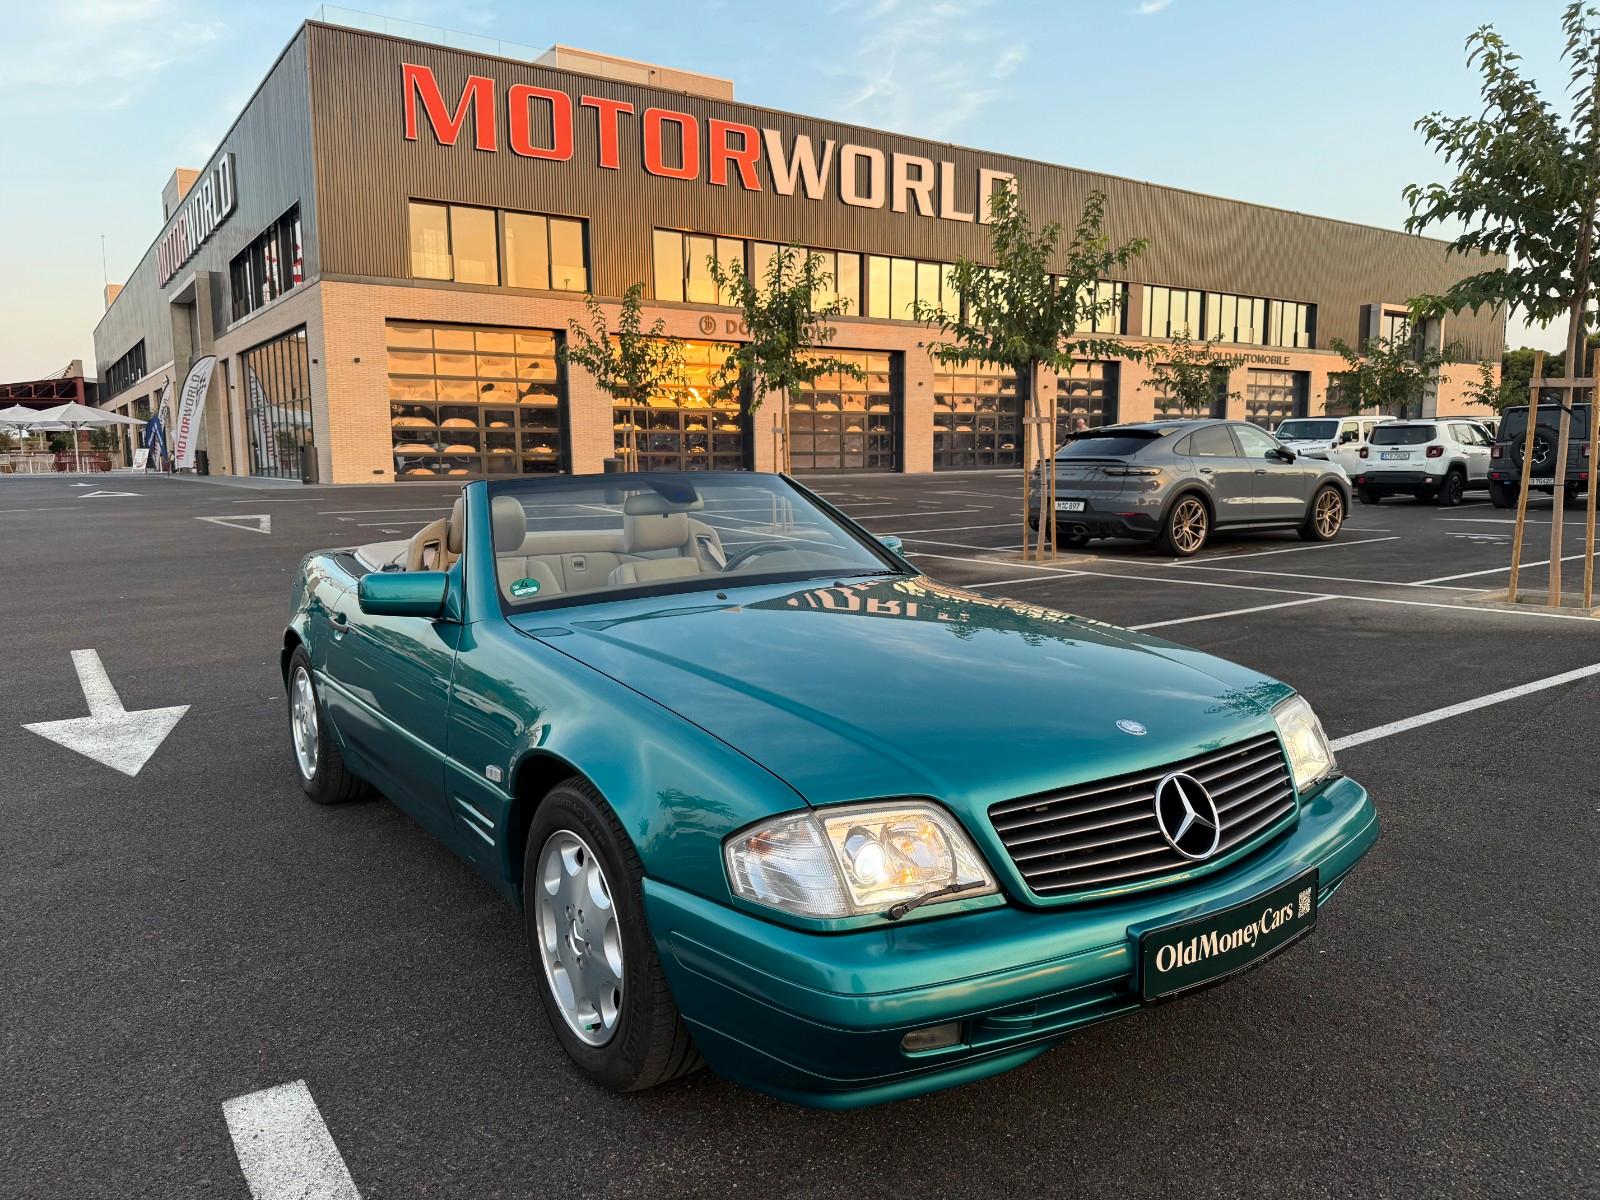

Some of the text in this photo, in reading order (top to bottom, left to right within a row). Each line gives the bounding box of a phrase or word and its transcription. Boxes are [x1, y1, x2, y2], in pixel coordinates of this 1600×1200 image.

[401, 62, 1018, 225] MOTORWORLD
[156, 152, 232, 287] MOTORWORLD
[1233, 352, 1290, 366] AUTOMOBILE
[176, 374, 200, 461] MOTORWORLD
[1155, 902, 1293, 973] OldMoneyCars
